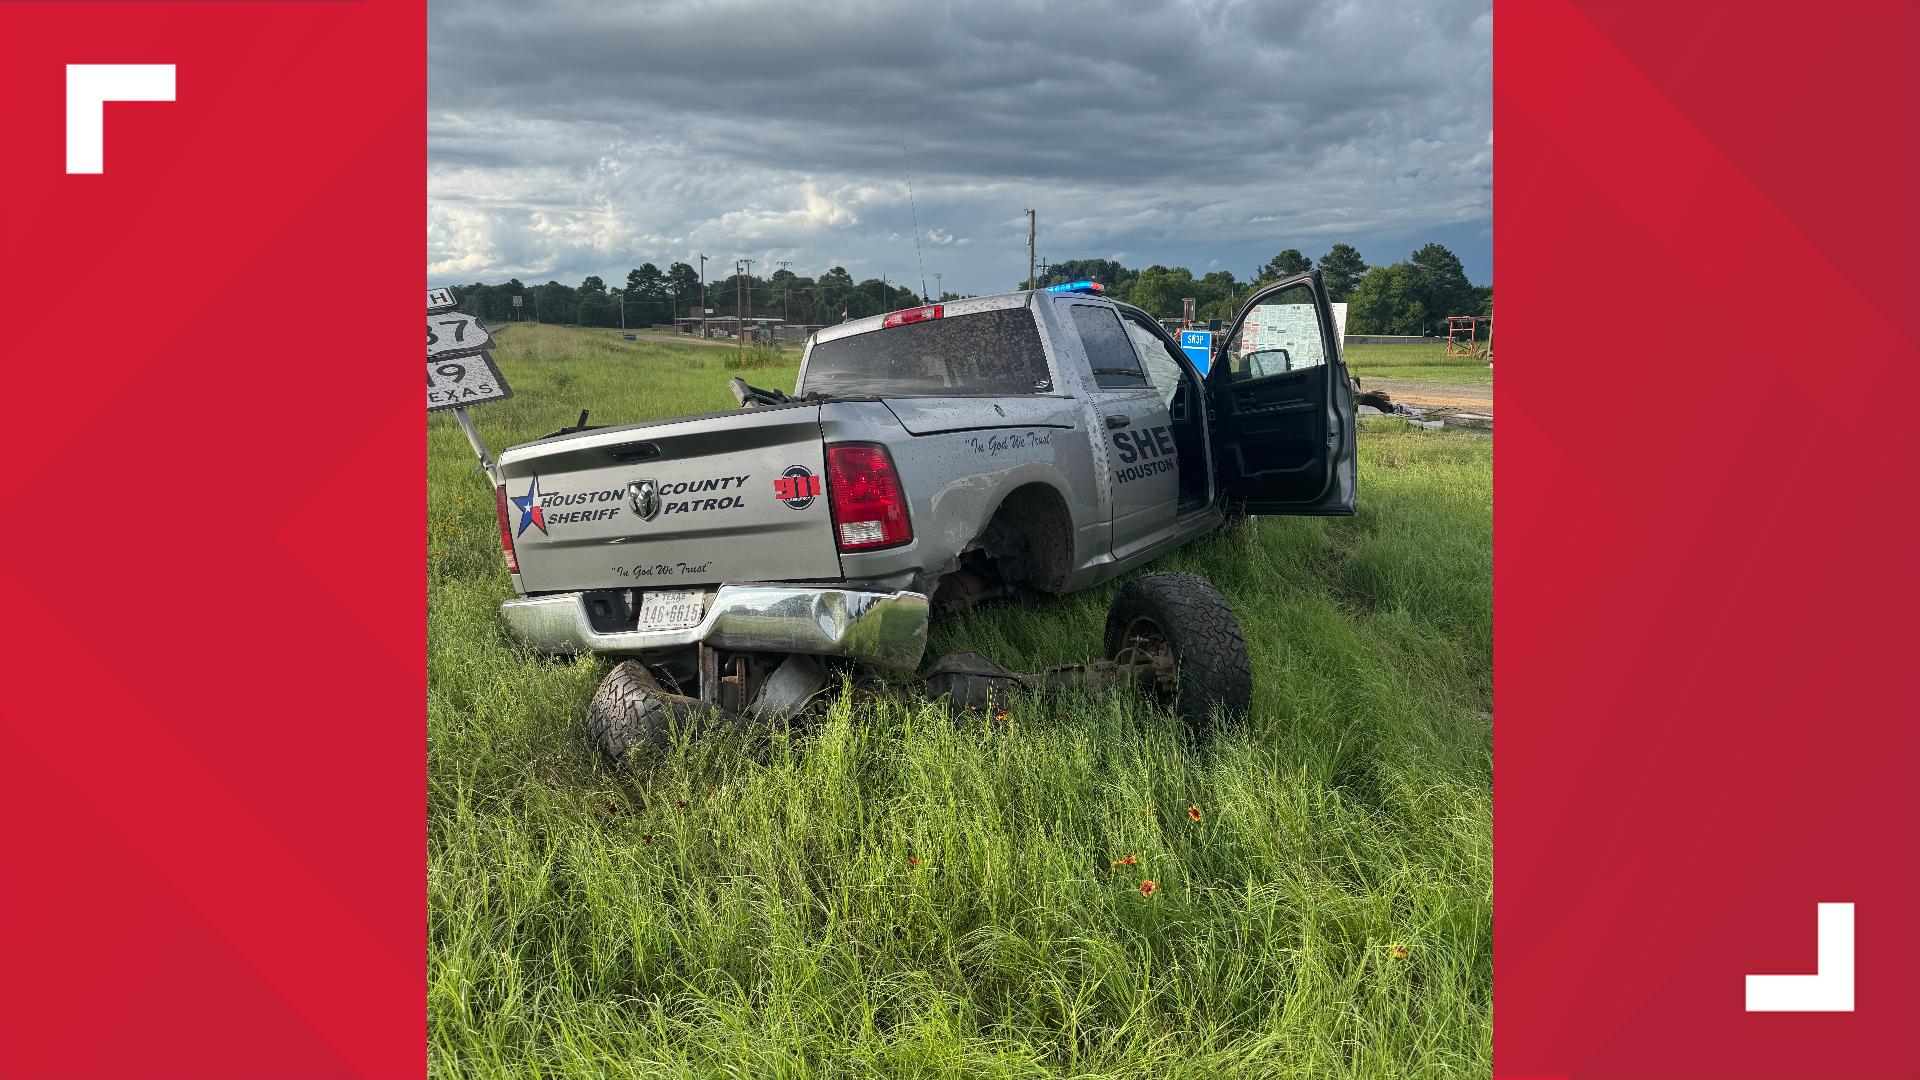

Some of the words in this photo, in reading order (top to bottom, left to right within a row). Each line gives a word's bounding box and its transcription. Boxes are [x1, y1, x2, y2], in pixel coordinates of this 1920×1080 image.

[1115, 459, 1175, 483] HOUSTON
[541, 489, 625, 508] HOUSTON
[659, 475, 751, 496] COUNTY
[774, 475, 821, 500] 911
[548, 508, 620, 525] SHERIFF
[664, 496, 745, 515] PATROL
[633, 565, 653, 579] God
[656, 565, 674, 575] We
[662, 592, 686, 601] TEXAS
